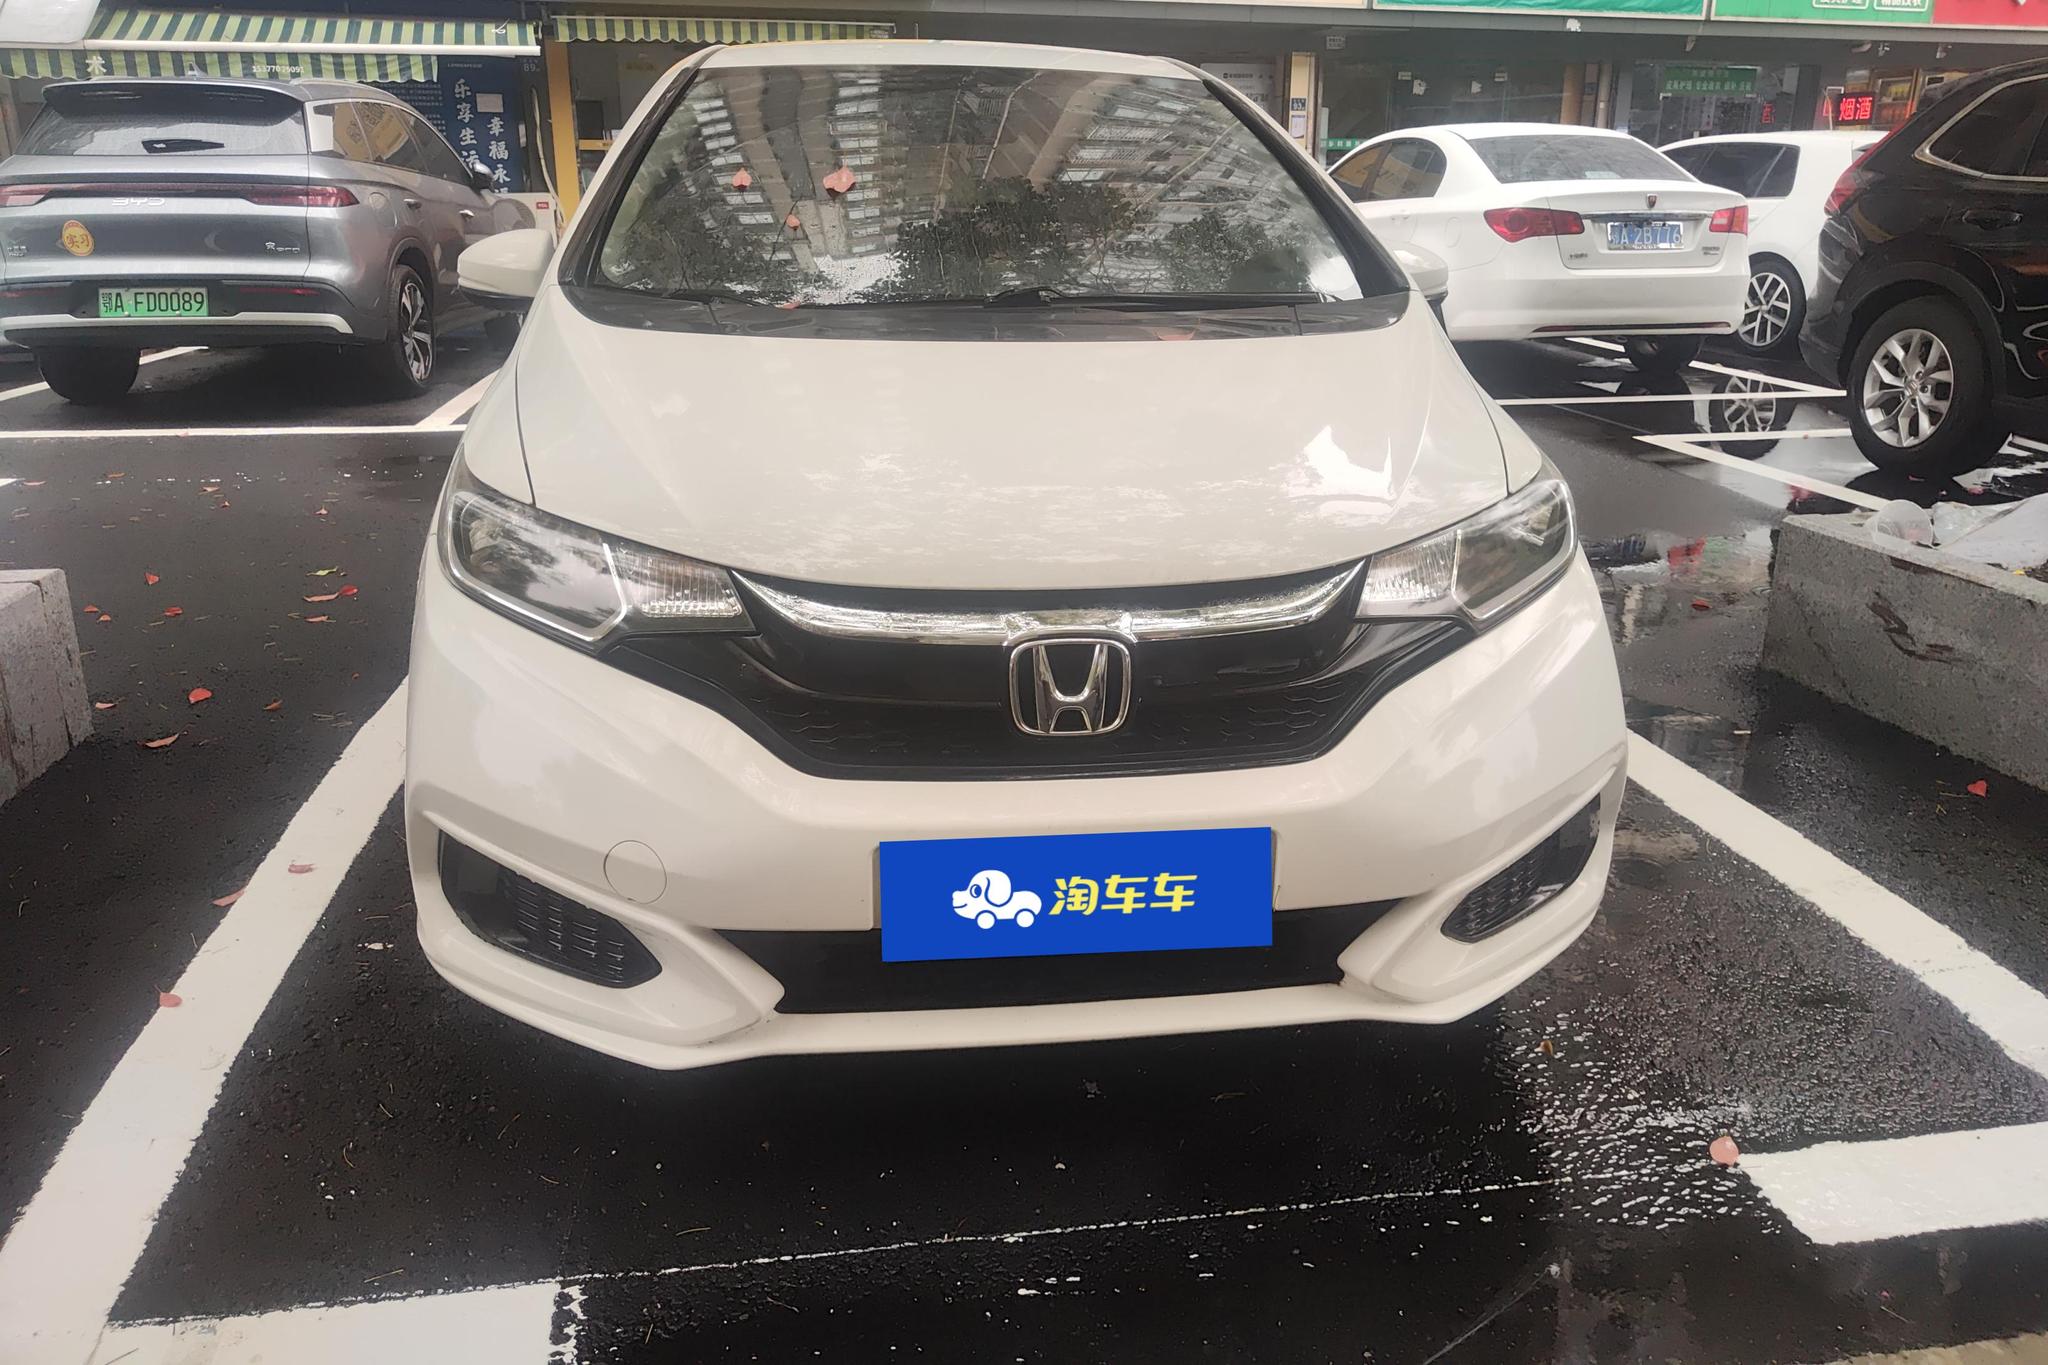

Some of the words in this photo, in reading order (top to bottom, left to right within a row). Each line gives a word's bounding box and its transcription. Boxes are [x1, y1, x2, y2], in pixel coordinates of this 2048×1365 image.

[86, 56, 106, 75] 术
[1839, 97, 1873, 120] 烟酒
[487, 117, 511, 193] 幸福永
